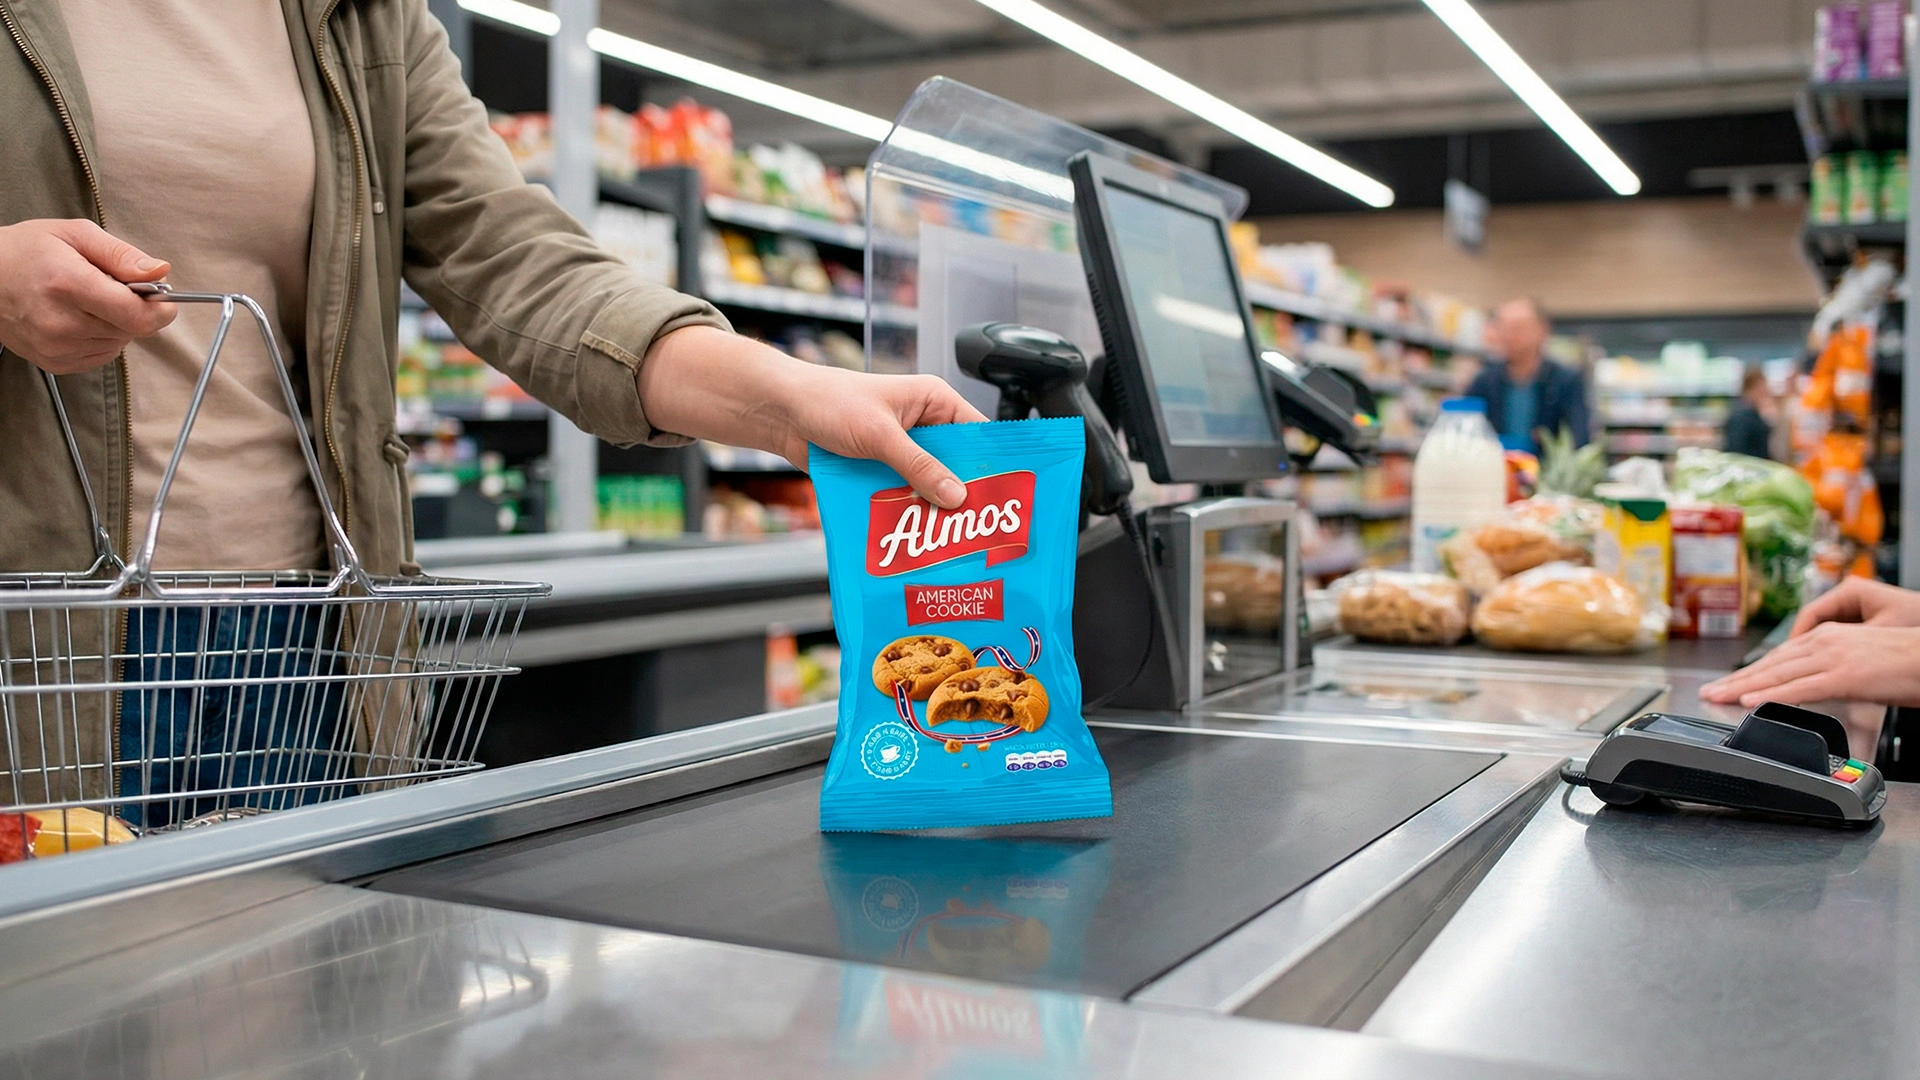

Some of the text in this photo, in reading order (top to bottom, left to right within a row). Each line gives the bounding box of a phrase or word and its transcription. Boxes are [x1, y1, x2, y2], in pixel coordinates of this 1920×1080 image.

[879, 499, 1021, 567] Almos
[916, 587, 993, 604] AMERICAN
[926, 602, 985, 617] COOKIE
